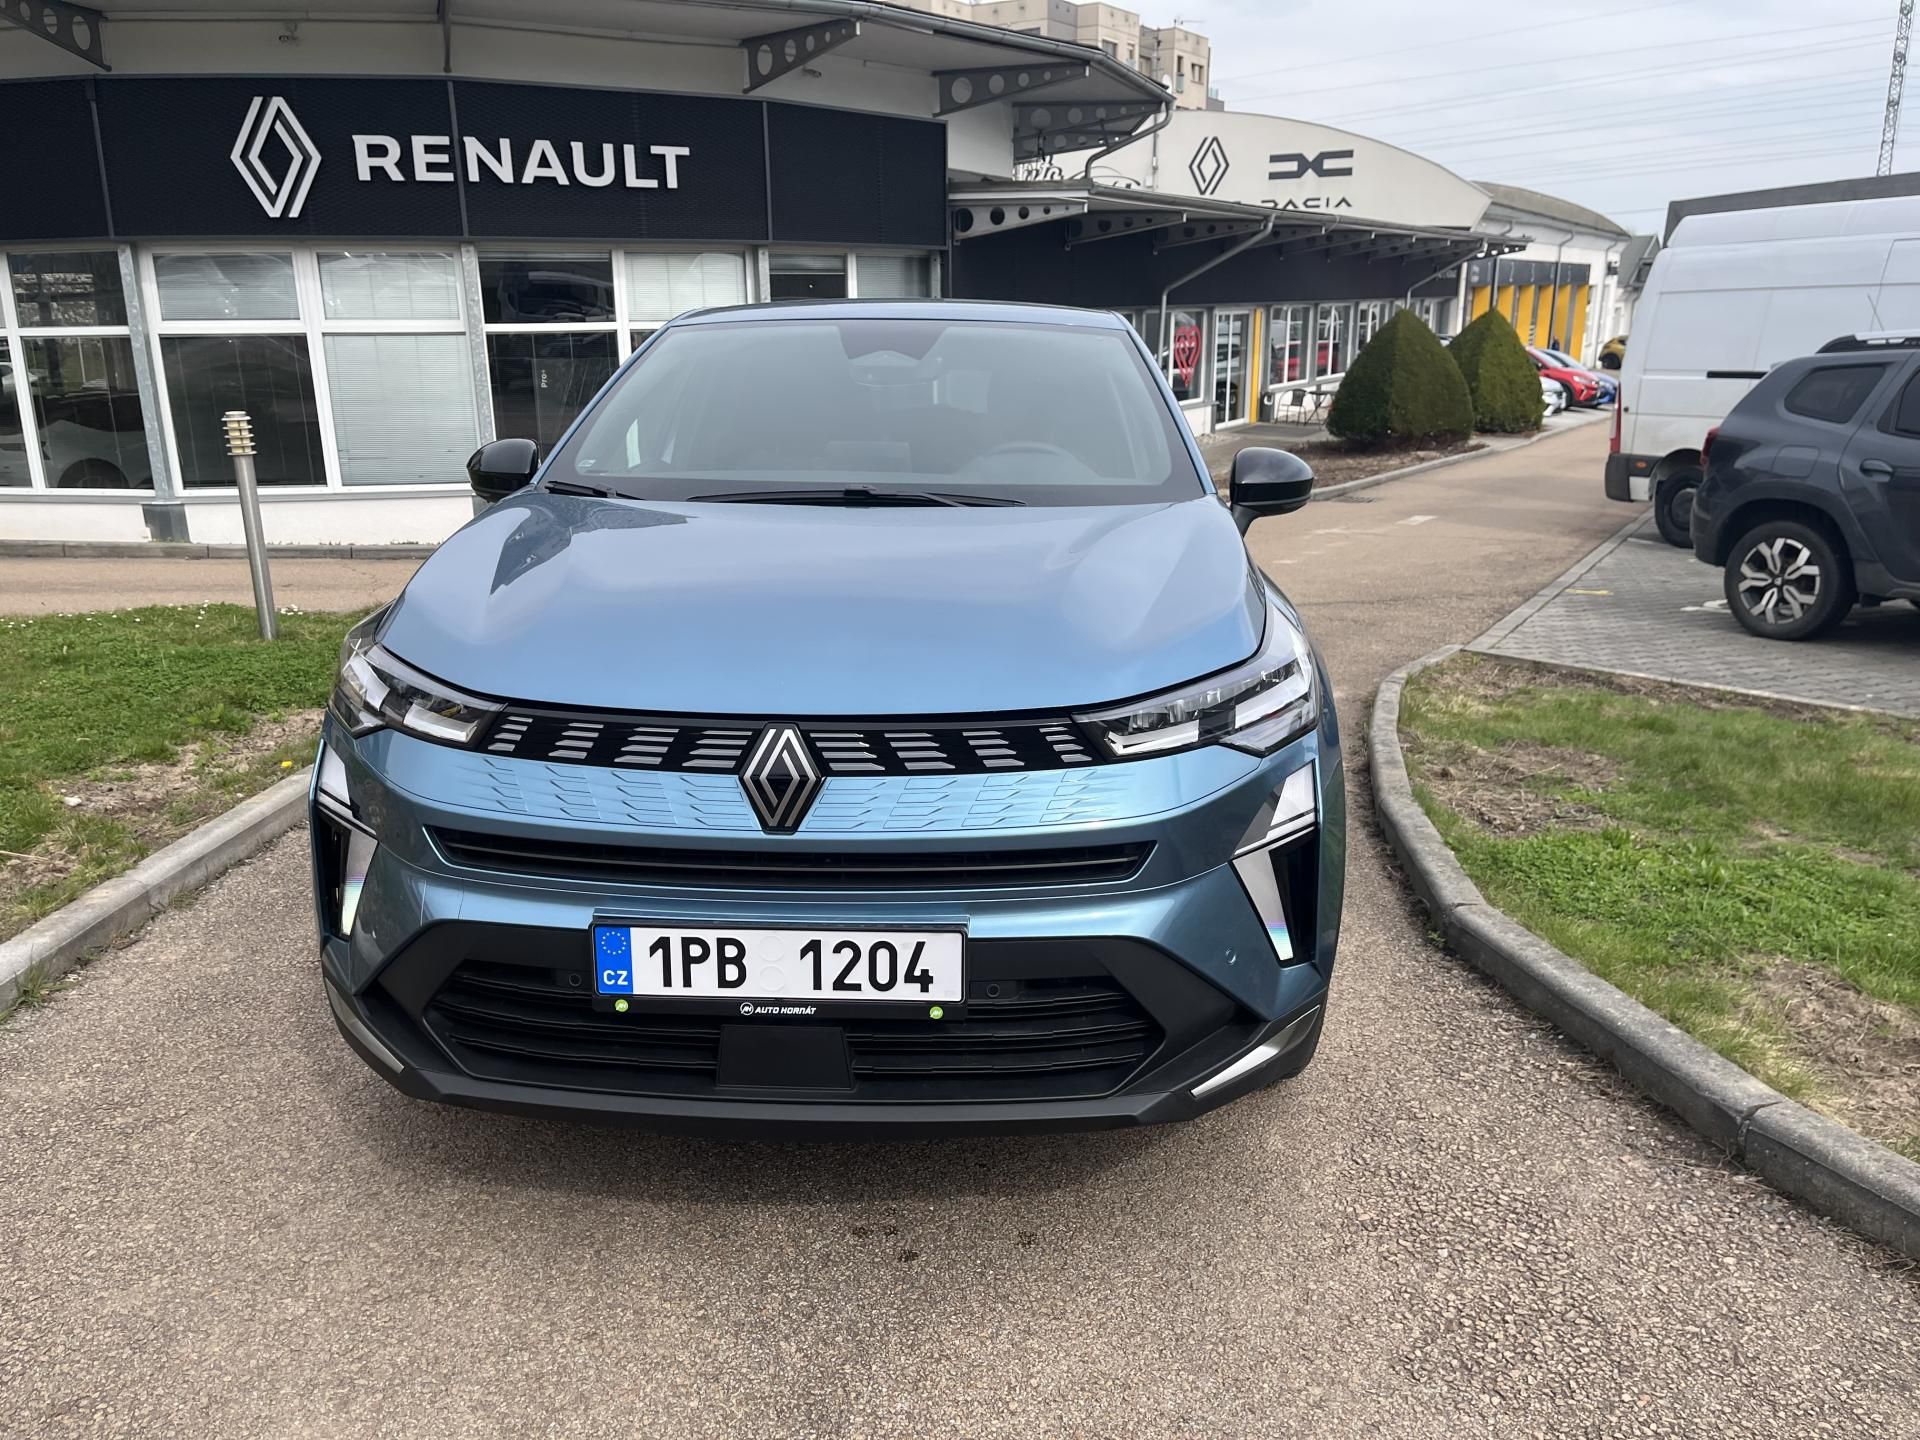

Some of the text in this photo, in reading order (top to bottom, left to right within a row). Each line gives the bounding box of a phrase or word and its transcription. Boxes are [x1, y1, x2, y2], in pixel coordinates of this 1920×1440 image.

[351, 134, 690, 189] RENAULT
[1261, 197, 1353, 210] DACIA
[603, 936, 934, 993] CZ 1PB 1204
[755, 1006, 780, 1014] AUTO
[780, 1005, 817, 1015] HORNÁT
